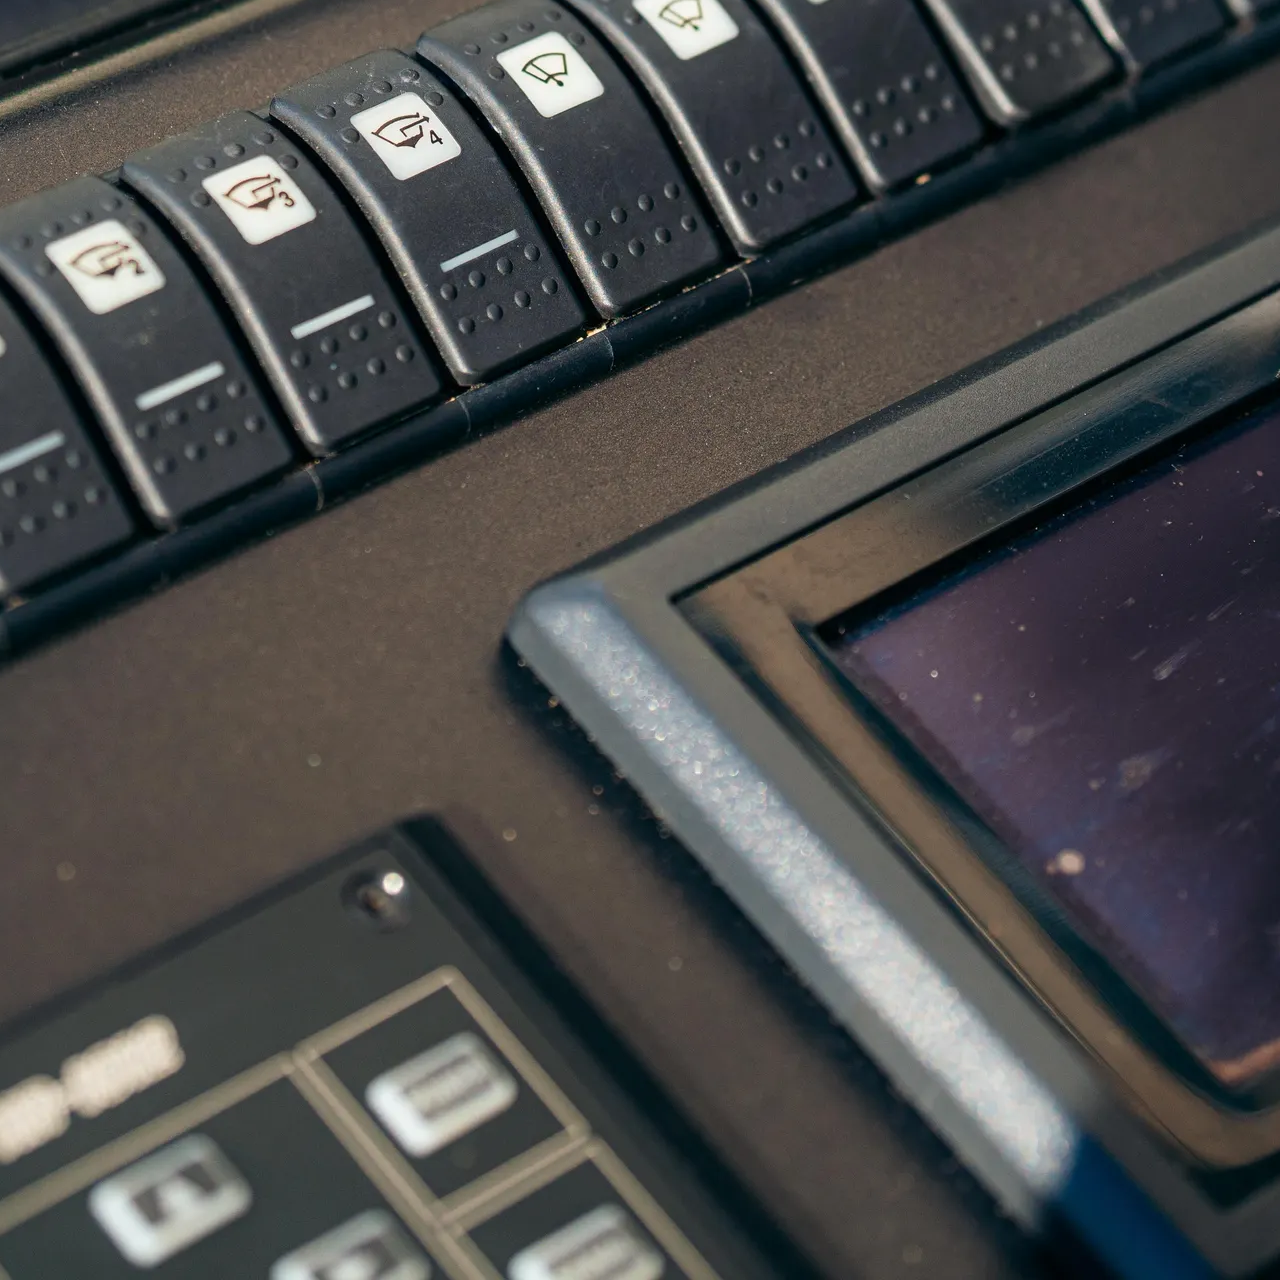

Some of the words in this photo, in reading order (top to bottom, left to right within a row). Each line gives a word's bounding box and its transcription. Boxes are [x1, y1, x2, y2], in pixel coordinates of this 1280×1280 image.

[429, 129, 443, 145] 4
[278, 191, 295, 208] 3
[127, 257, 144, 274] 2
